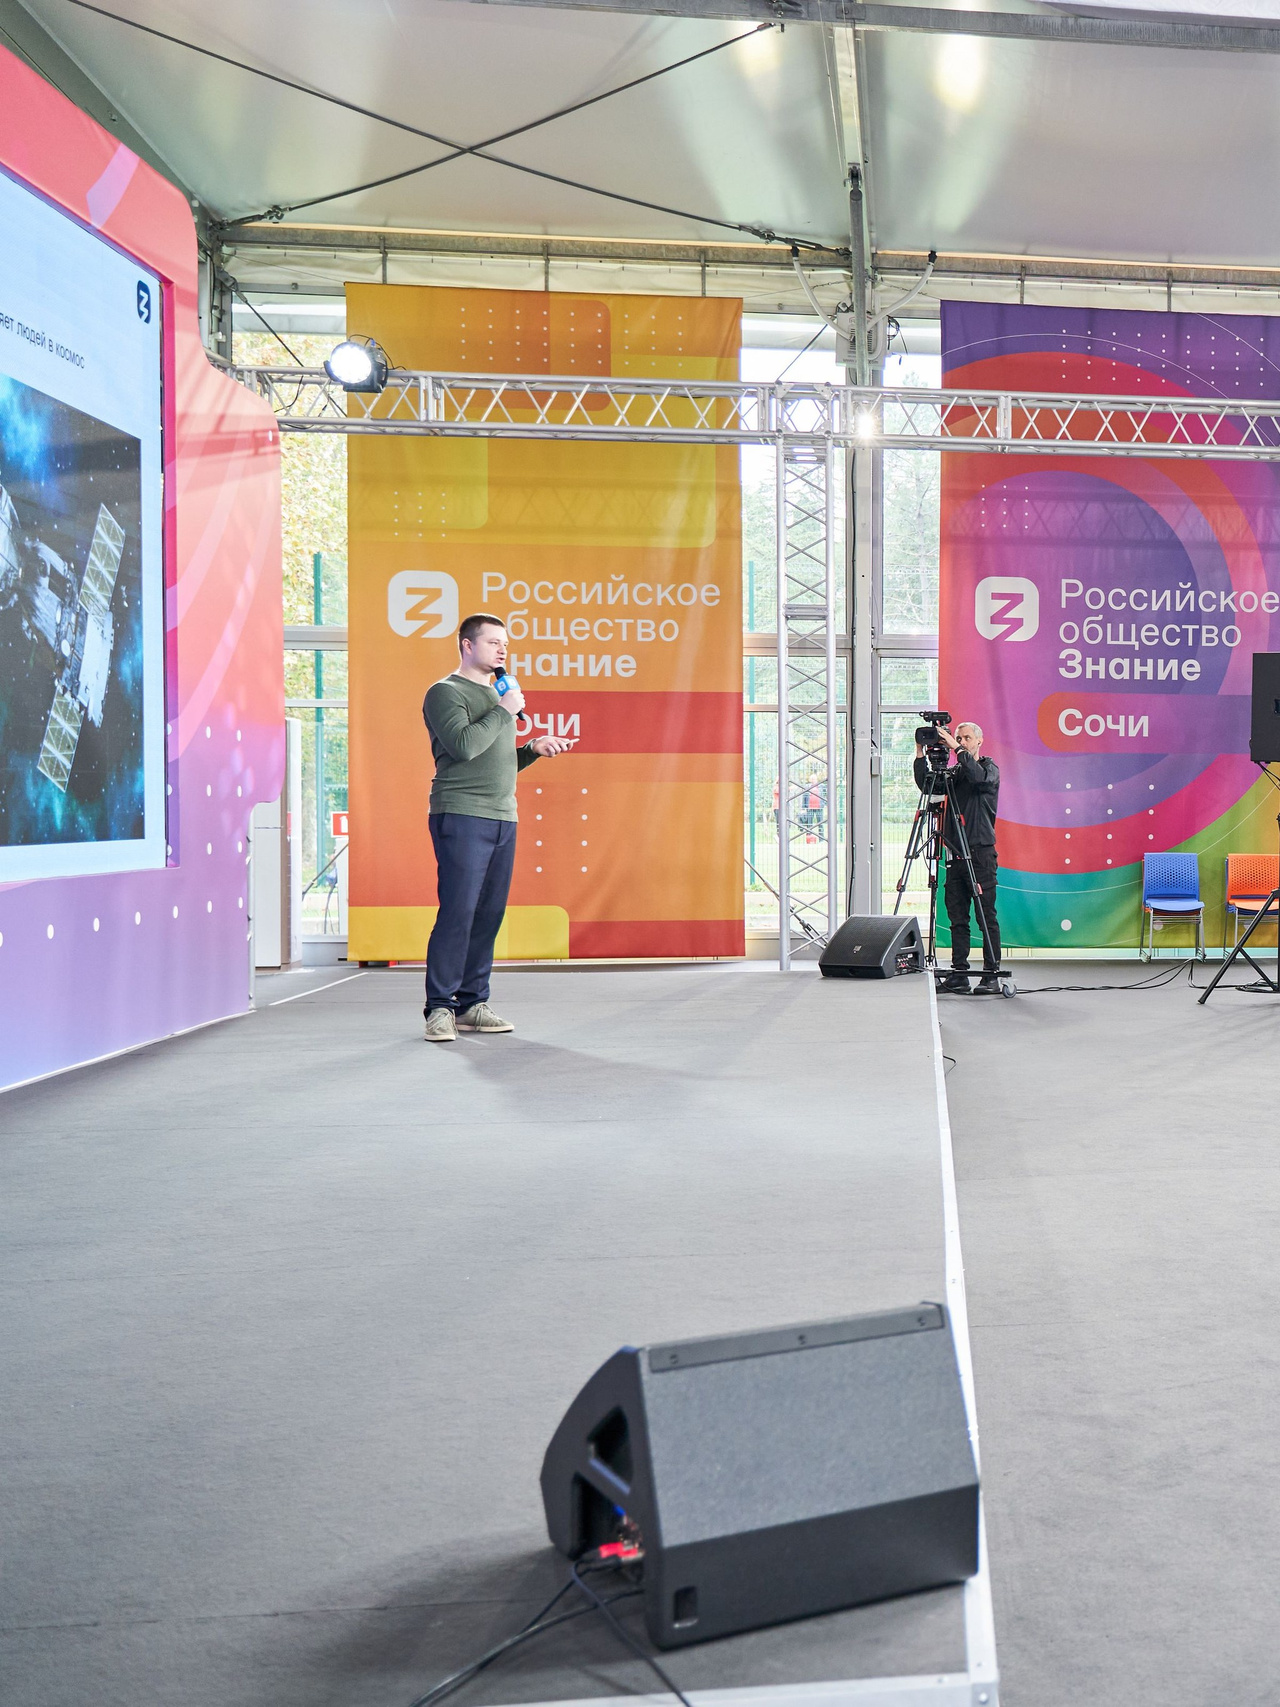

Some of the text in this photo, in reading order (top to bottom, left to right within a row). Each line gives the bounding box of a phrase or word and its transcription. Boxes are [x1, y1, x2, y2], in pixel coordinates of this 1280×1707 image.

[17, 322, 46, 349] людей
[49, 339, 54, 353] в
[56, 343, 85, 369] космос
[482, 571, 721, 607] Российское
[1060, 578, 1280, 614] Российское
[506, 608, 679, 646] бщество
[1059, 615, 1242, 651] общество
[504, 653, 637, 678] нание
[1058, 648, 1201, 681] Знание
[516, 713, 580, 738] очи
[1058, 708, 1149, 738] Сочи
